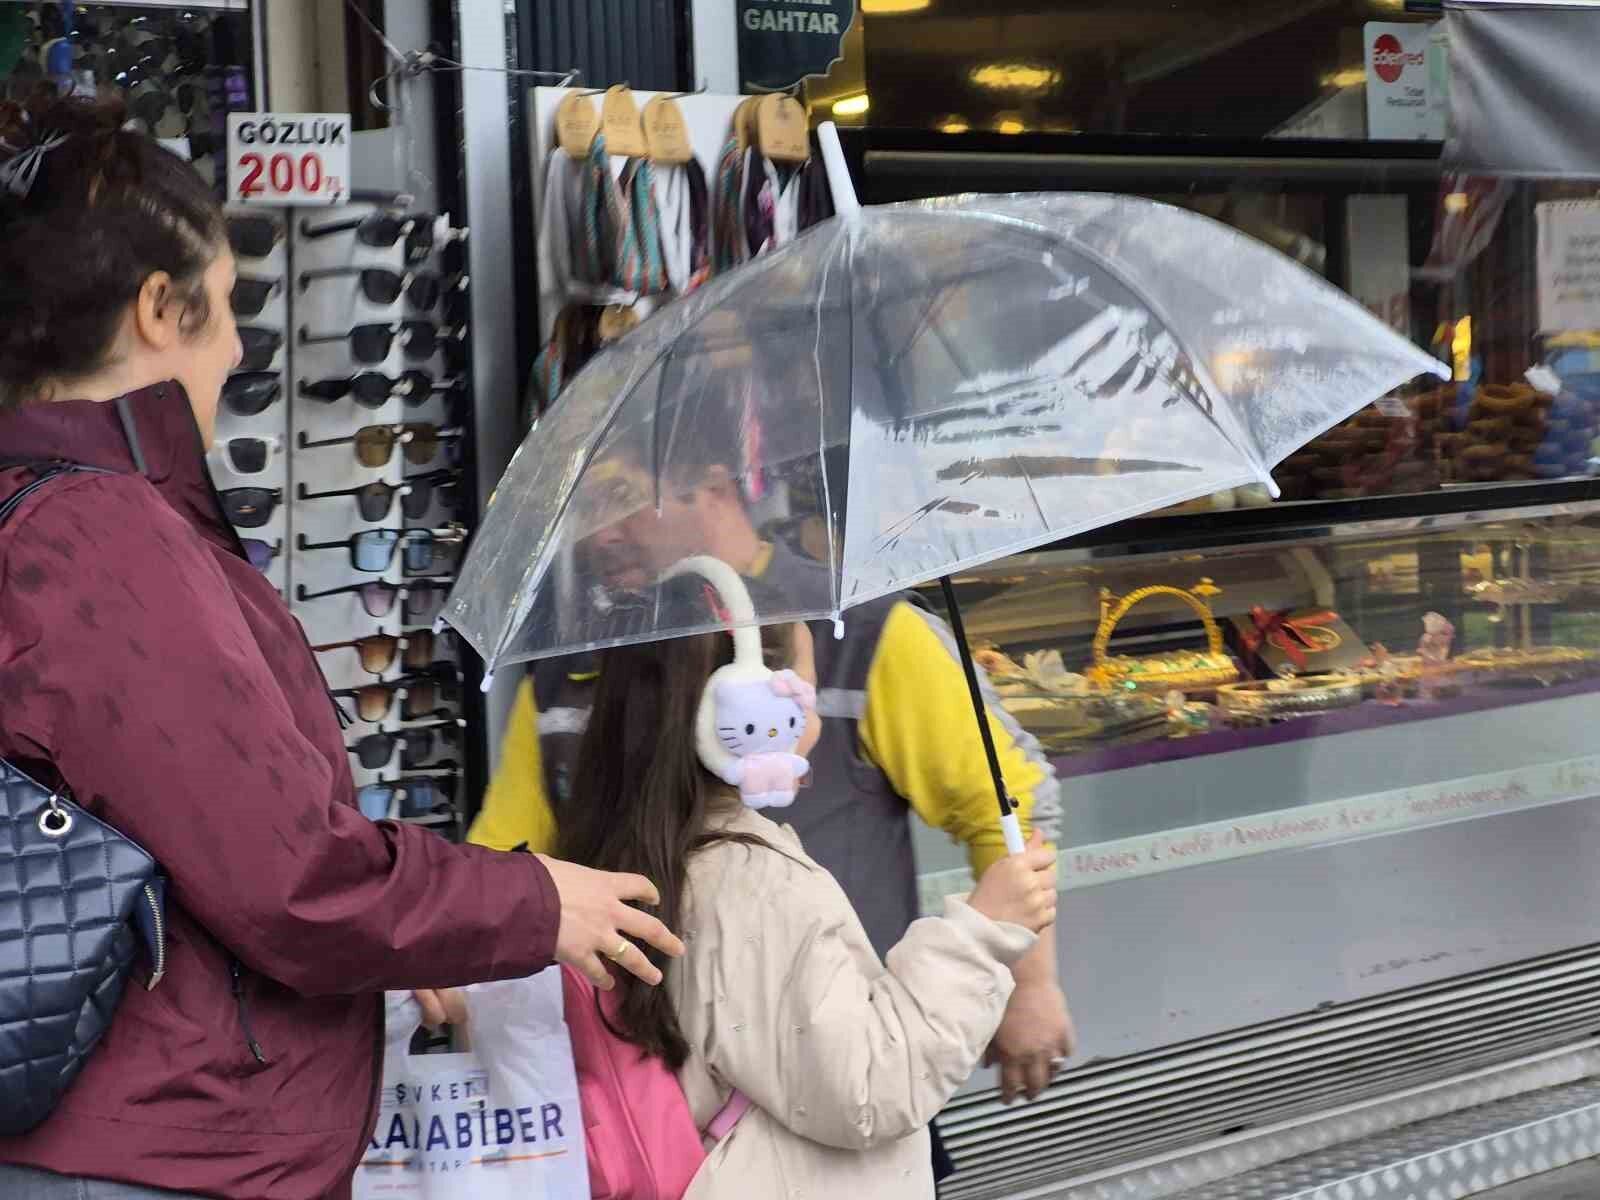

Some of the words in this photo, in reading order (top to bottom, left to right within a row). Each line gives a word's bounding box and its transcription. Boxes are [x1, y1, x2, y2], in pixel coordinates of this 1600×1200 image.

[744, 8, 840, 34] GAHTAR
[238, 117, 345, 144] GÖZLÜK
[238, 152, 321, 193] 200
